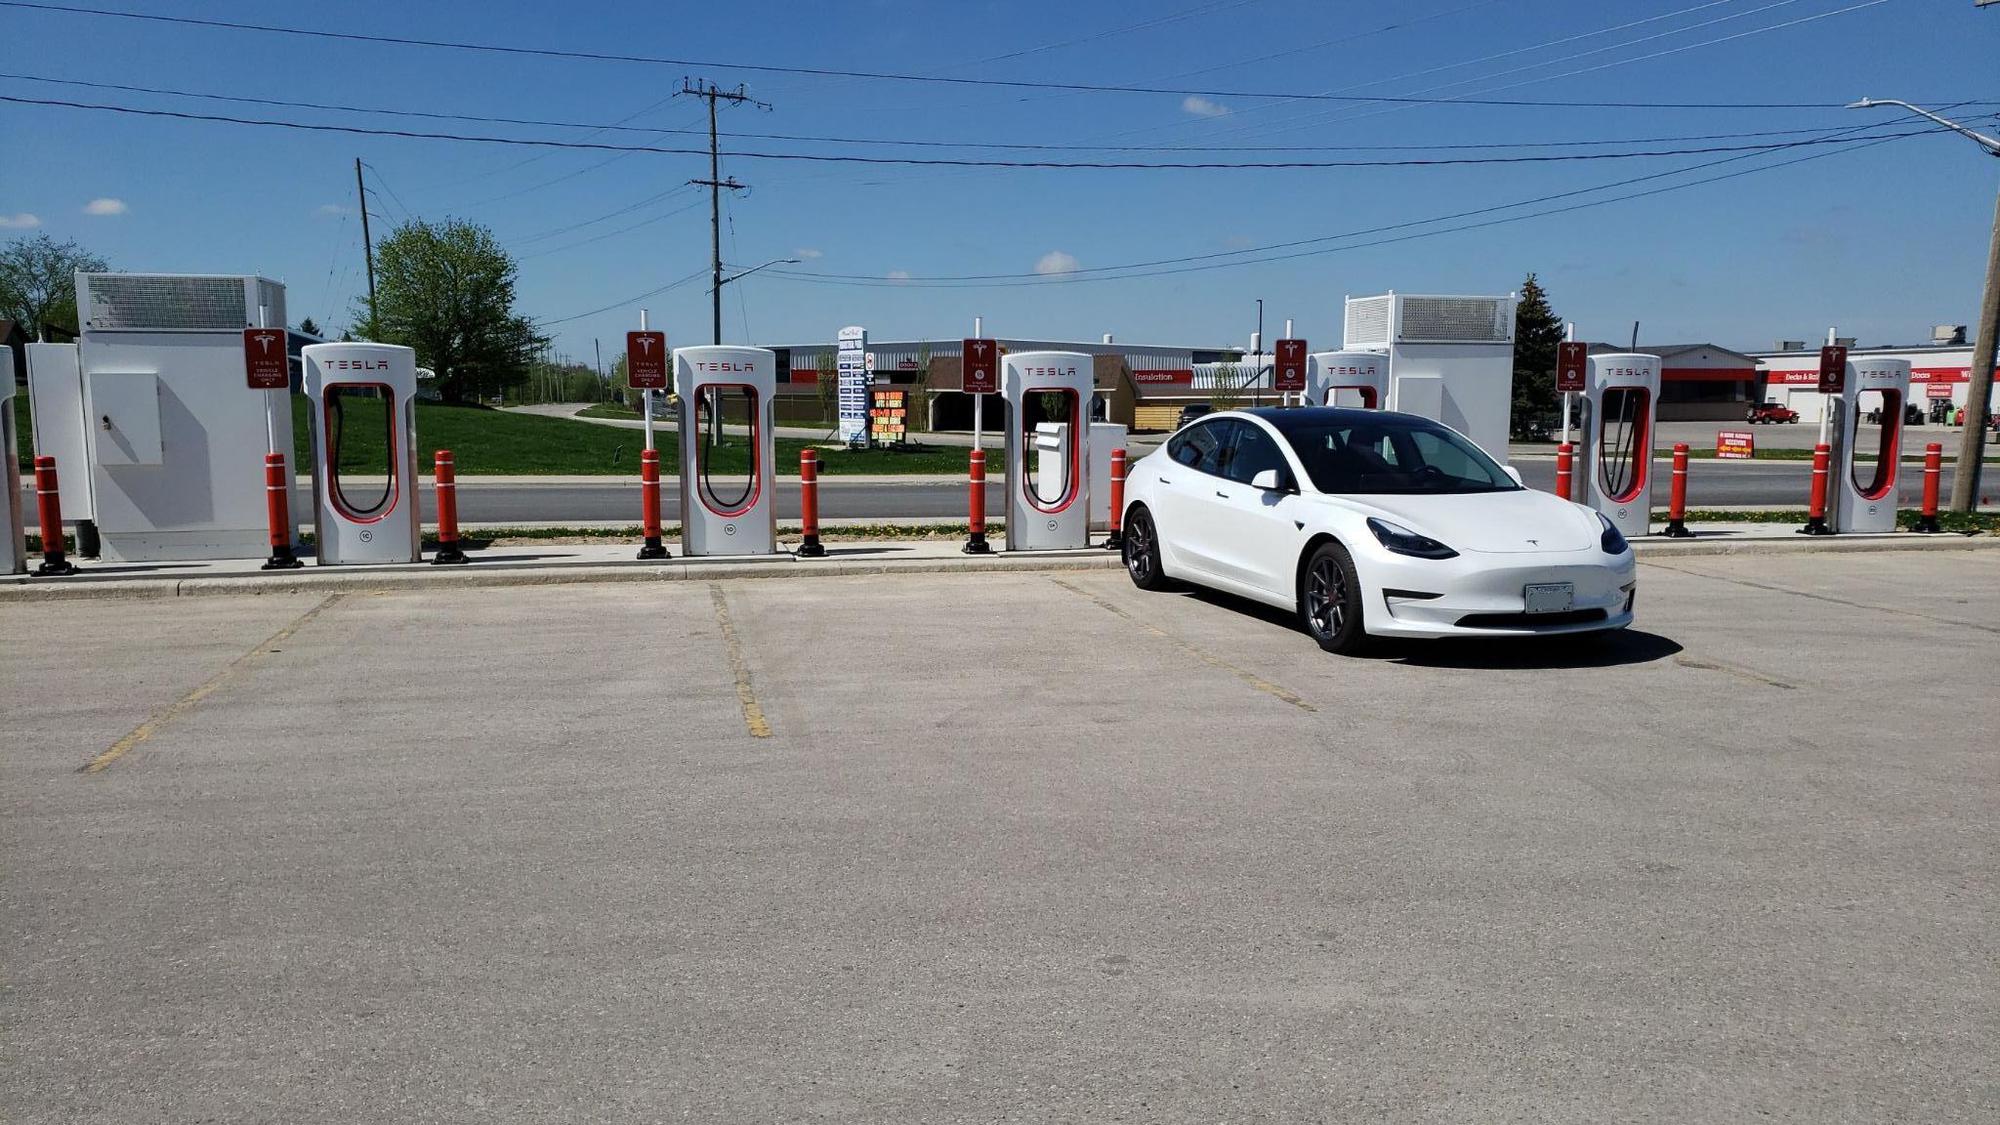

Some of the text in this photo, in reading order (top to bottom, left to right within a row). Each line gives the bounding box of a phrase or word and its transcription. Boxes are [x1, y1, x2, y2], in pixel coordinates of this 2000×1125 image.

[324, 360, 389, 370] TESLA
[696, 362, 755, 372] TESLA
[1025, 367, 1077, 376] TESLA
[1328, 367, 1376, 375] TESLA
[1606, 368, 1650, 376] TESLA
[1861, 370, 1902, 379] TESLA
[1134, 373, 1173, 381] Insulation
